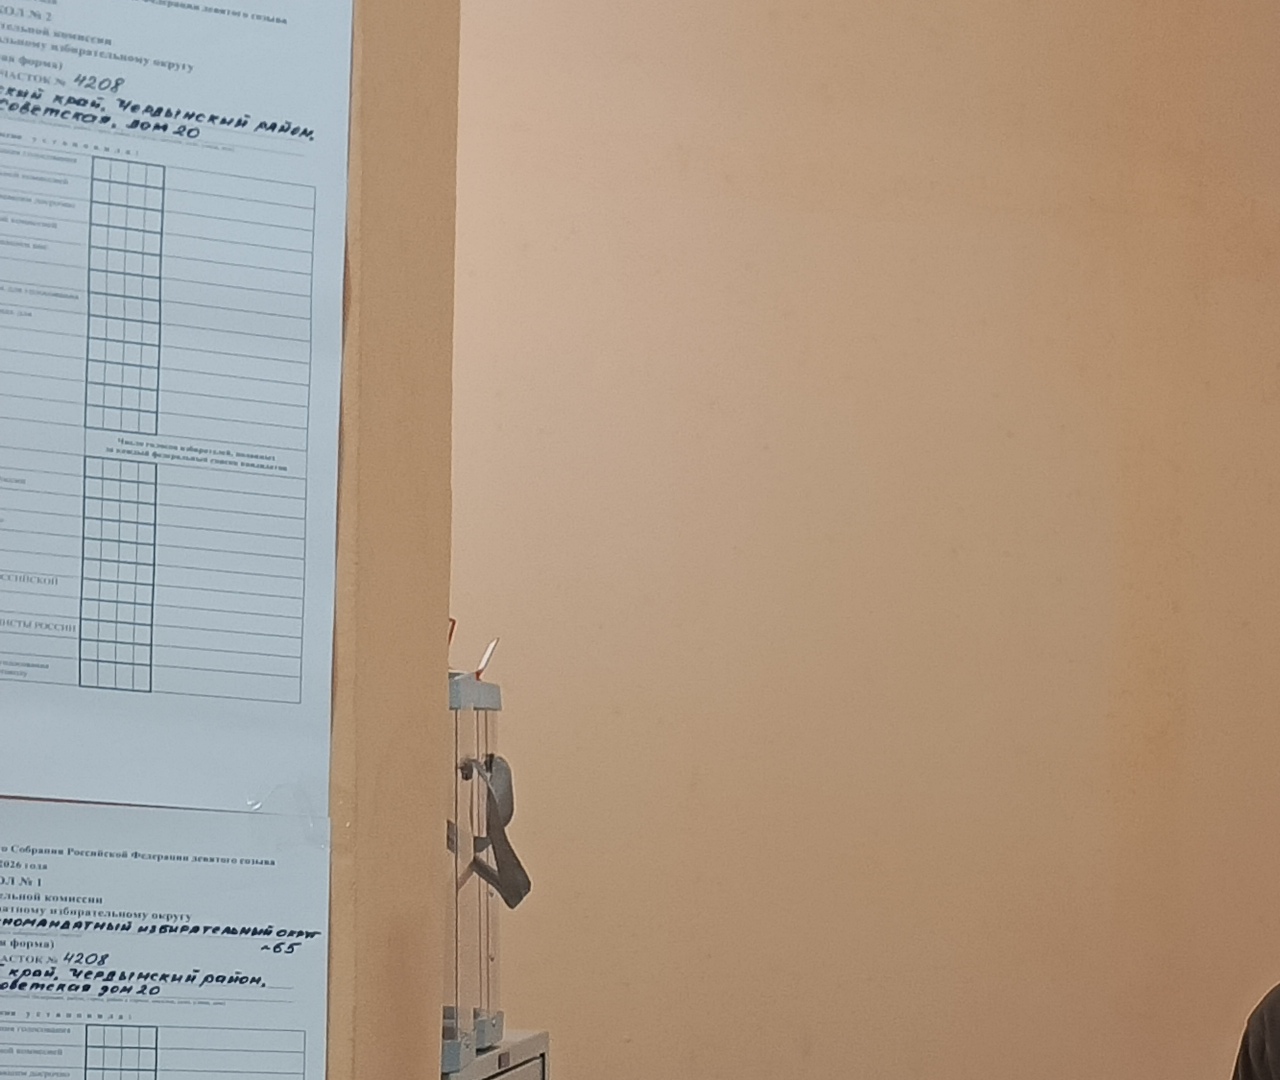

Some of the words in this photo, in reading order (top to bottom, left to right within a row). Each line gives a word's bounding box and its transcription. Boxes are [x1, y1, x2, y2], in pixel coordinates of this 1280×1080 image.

[45, 11, 52, 22] 2
[73, 73, 125, 94] 4208
[172, 125, 201, 139] 20
[0, 573, 59, 586] ССИЙСКОЙ
[11, 844, 64, 856] Собрания
[67, 847, 128, 859] Российской
[130, 851, 190, 863] Федерации
[44, 895, 103, 905] комиссии
[50, 907, 150, 921] избирательному
[151, 912, 192, 923] округу
[0, 917, 132, 932] номандатный
[137, 921, 274, 938] избирательный
[10, 938, 55, 950] форма)
[63, 951, 110, 967] 4208
[98, 985, 134, 997] дом
[136, 984, 161, 996] 20
